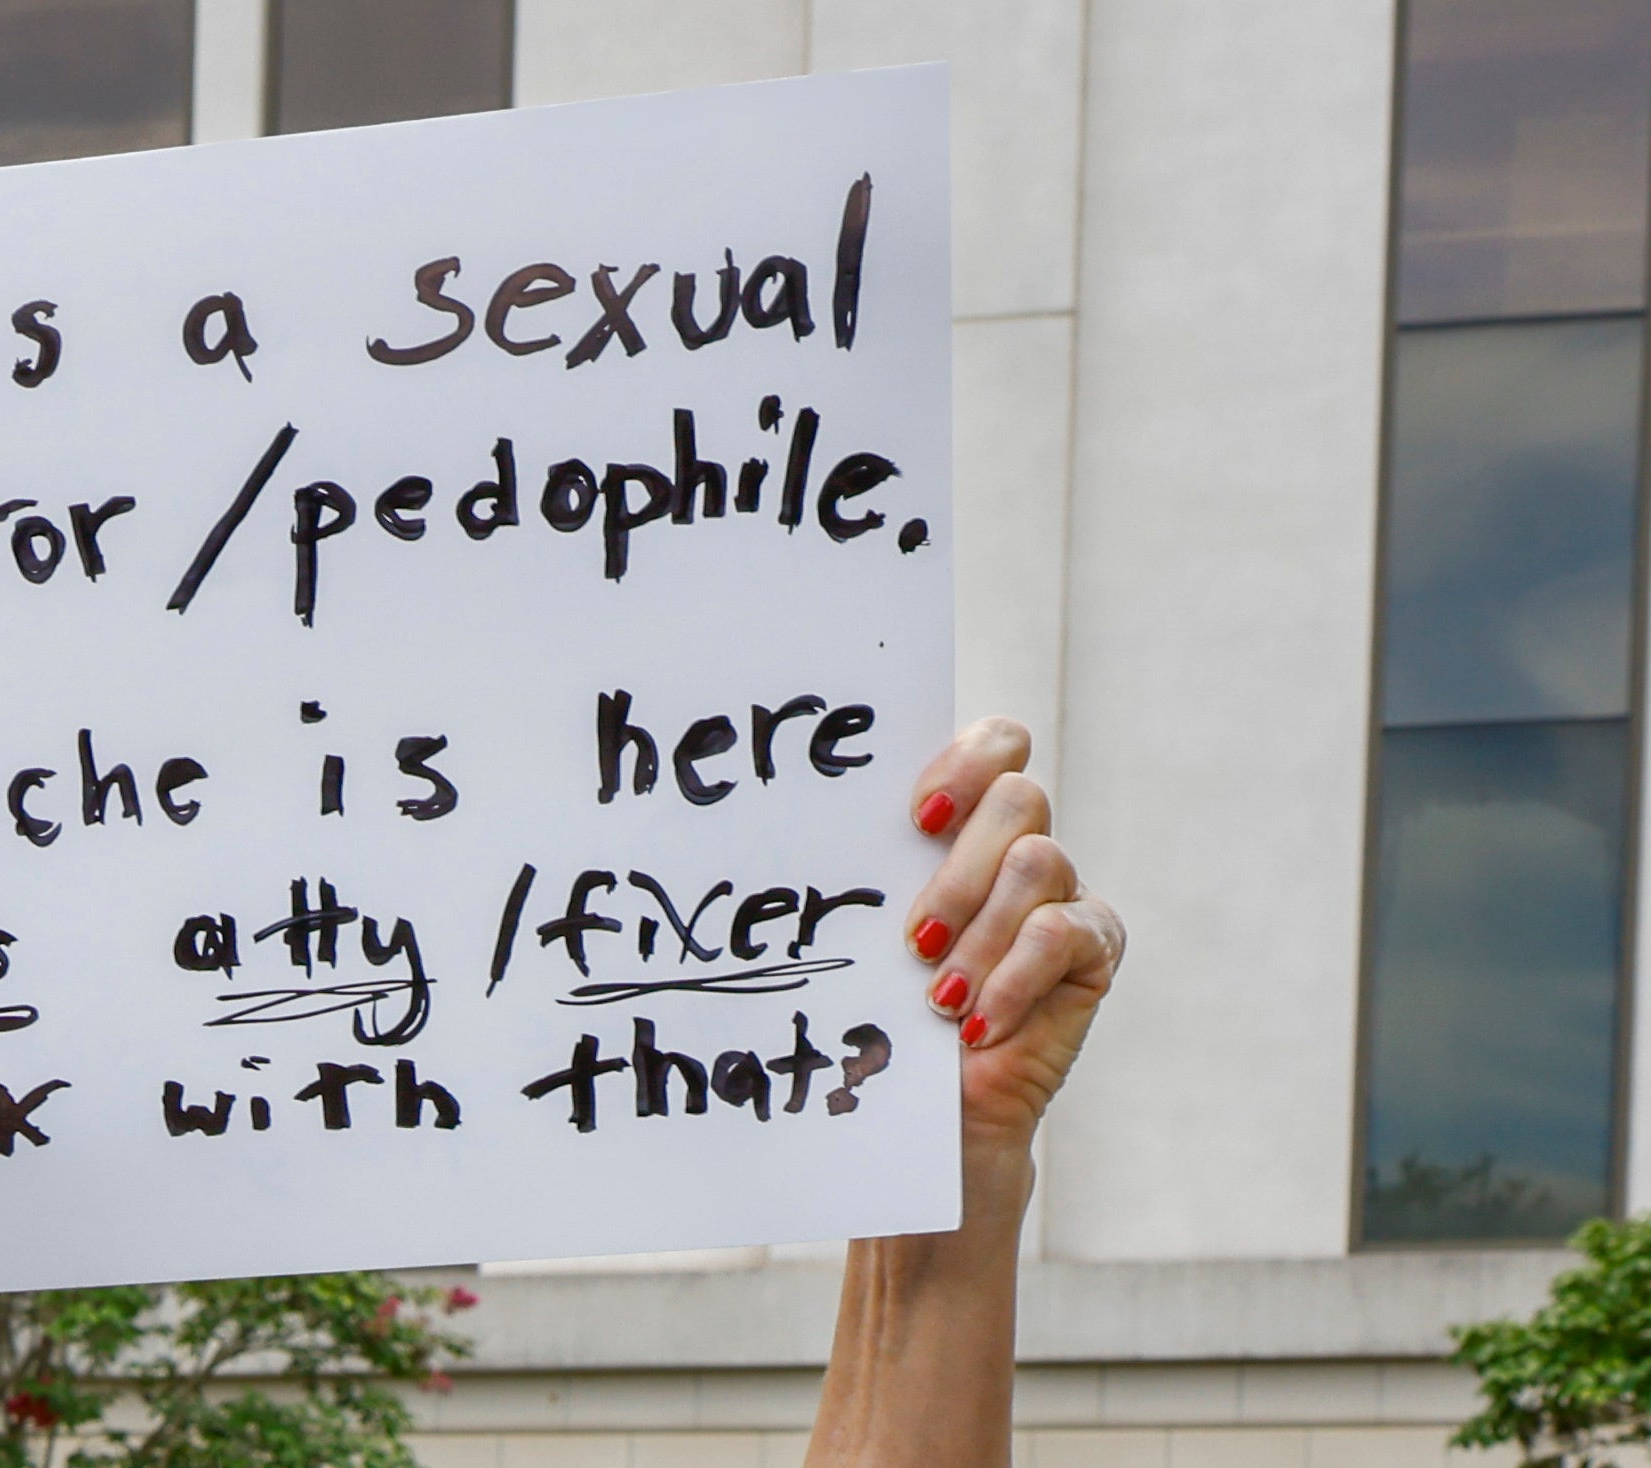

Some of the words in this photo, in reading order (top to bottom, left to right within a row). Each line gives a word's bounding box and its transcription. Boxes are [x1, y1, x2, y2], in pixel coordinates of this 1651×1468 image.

[182, 291, 259, 383] a
[365, 171, 874, 370] sexual
[299, 700, 459, 823] is
[596, 688, 876, 807] here
[173, 876, 433, 1047] atty
[161, 1055, 462, 1137] with
[520, 1010, 892, 1134] that?
